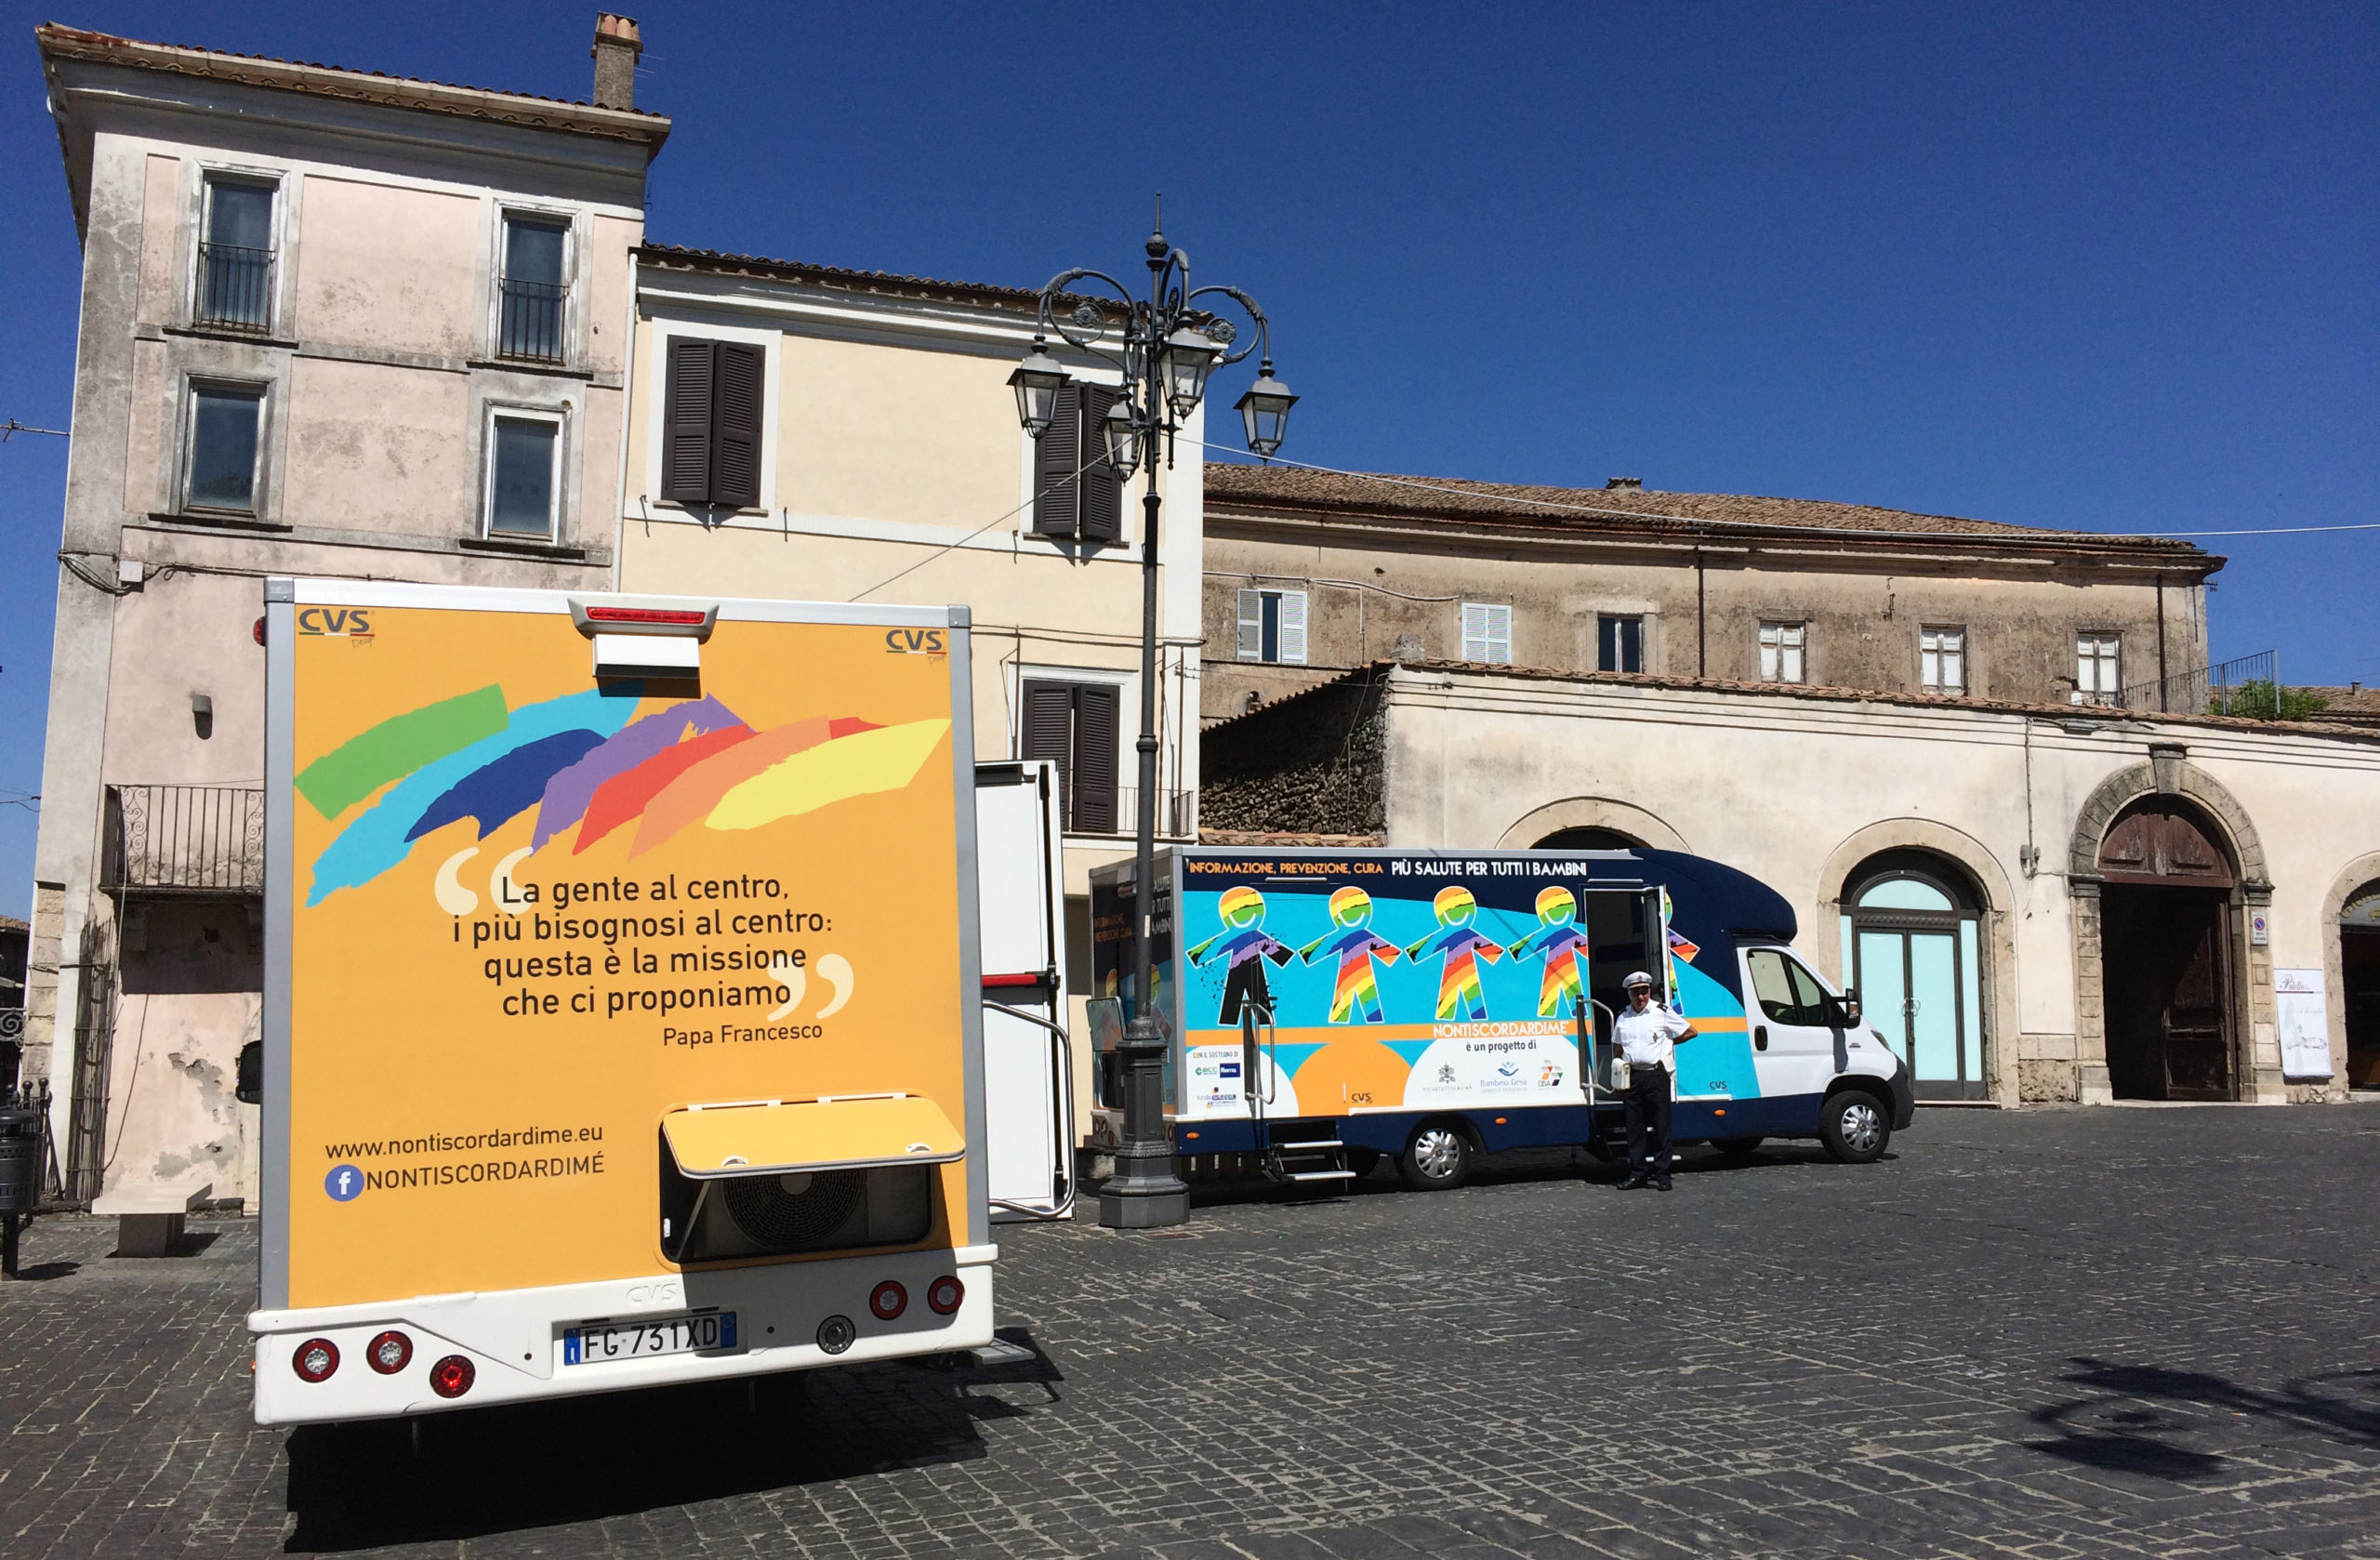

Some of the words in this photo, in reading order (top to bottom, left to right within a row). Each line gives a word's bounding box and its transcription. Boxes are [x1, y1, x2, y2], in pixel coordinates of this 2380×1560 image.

[298, 609, 370, 633] CVS
[886, 629, 943, 651] CVS
[1189, 862, 1276, 875] INFORMAZIONE,
[1280, 863, 1351, 875] PREVENZIONE,
[1354, 863, 1383, 874] CURA
[1391, 858, 1411, 876] PIÙ
[1415, 861, 1462, 876] SALUTE
[1466, 861, 1488, 876] PER
[1491, 862, 1523, 876] TUTTI
[1526, 862, 1530, 876] I
[1533, 862, 1587, 876] BAMBINI
[501, 876, 540, 905] La
[552, 876, 640, 910] gente
[650, 875, 678, 901] al
[687, 874, 789, 900] centro,
[454, 914, 459, 943] i
[473, 913, 521, 949] più
[535, 910, 684, 946] bisognosi
[695, 908, 722, 936] al
[732, 908, 832, 934] centro:
[484, 950, 591, 986] questa
[604, 947, 621, 975] è
[633, 946, 658, 974] la
[670, 943, 806, 972] missione
[502, 987, 560, 1016] che
[571, 985, 595, 1013] ci
[607, 982, 791, 1020] proponiamo
[664, 1027, 713, 1050] Papa
[721, 1025, 823, 1043] Francesco
[1466, 1041, 1472, 1051] è
[1474, 1043, 1486, 1051] un
[1488, 1040, 1526, 1053] progetto
[1527, 1039, 1537, 1050] di
[1351, 1092, 1371, 1103] CVS
[1709, 1080, 1727, 1091] CVS
[325, 1125, 602, 1159] www.nontiscordardime.eu
[366, 1151, 604, 1191] NONTISCORDARDIMÉ
[626, 1282, 677, 1302] CVS
